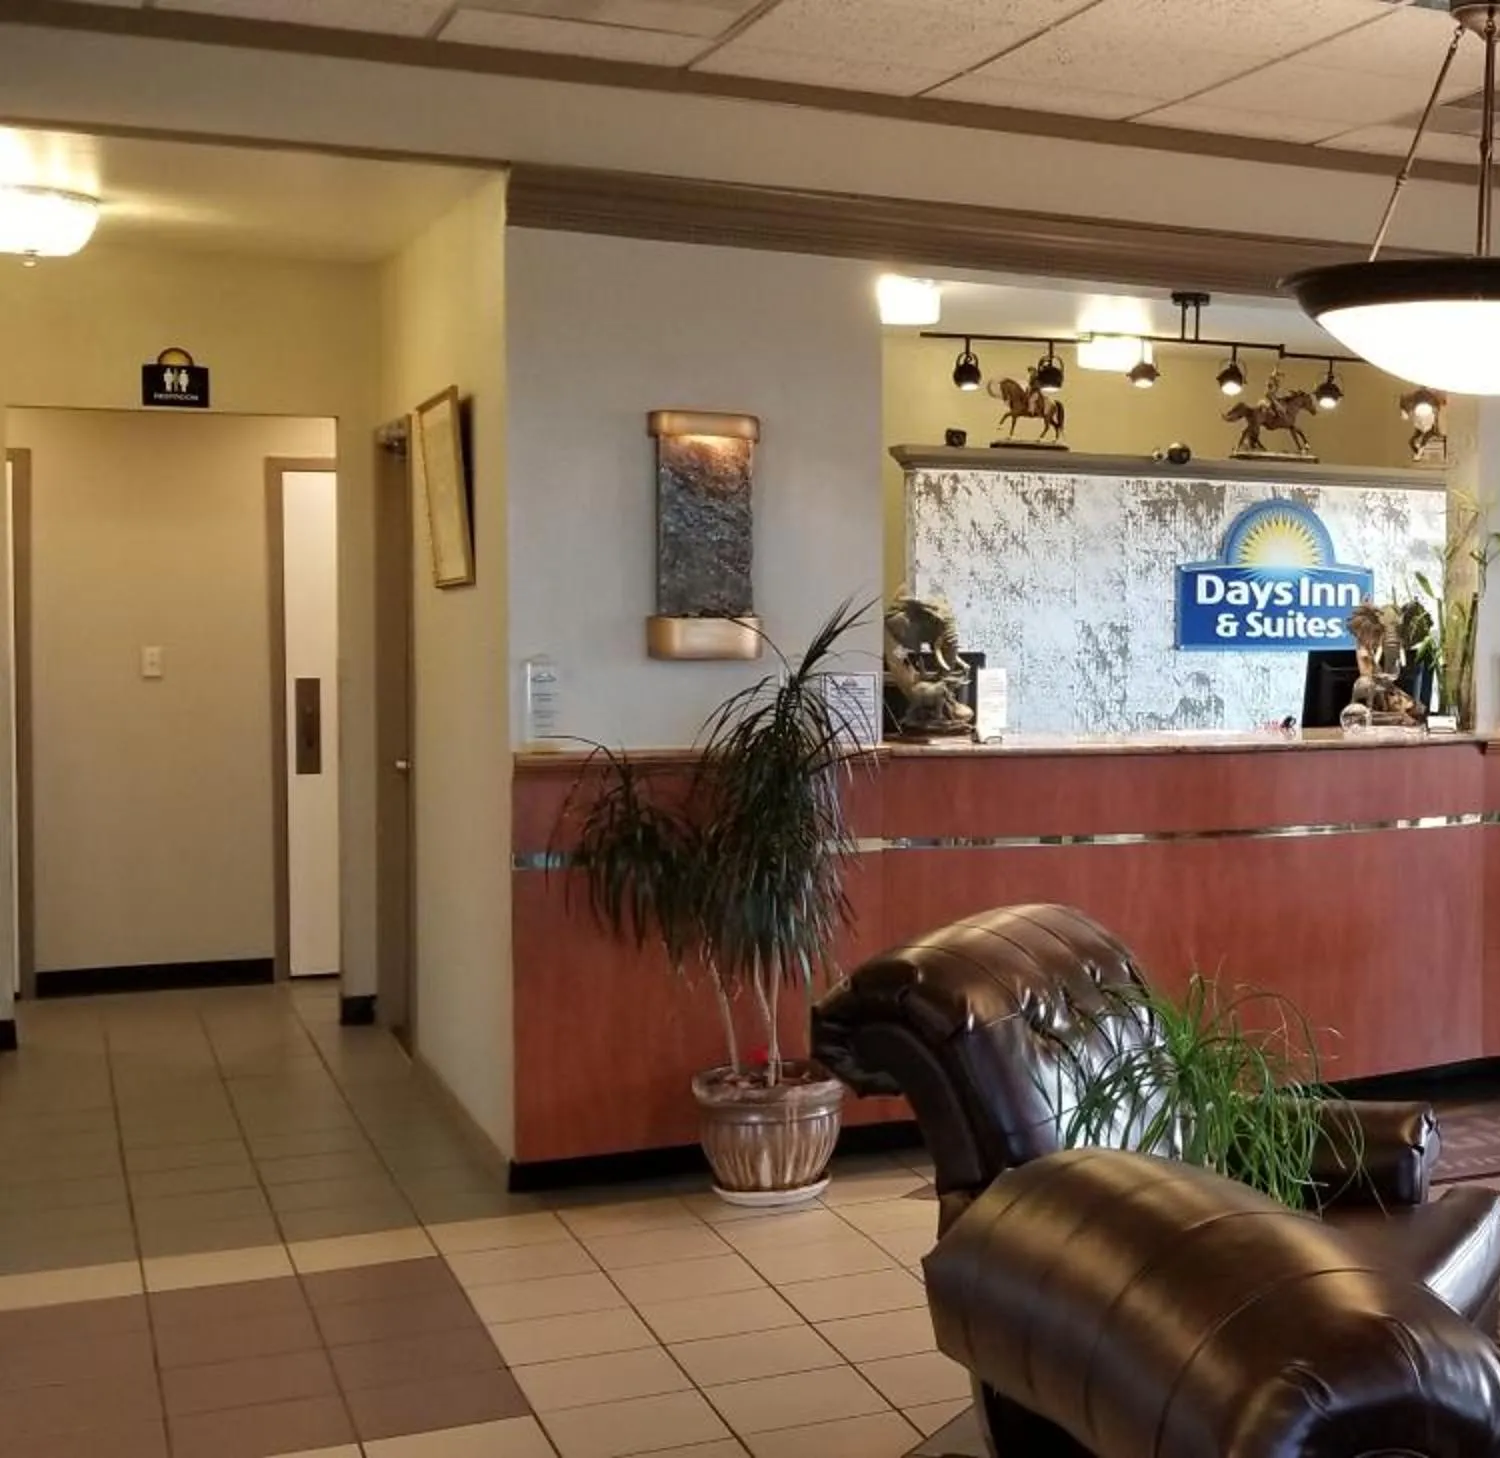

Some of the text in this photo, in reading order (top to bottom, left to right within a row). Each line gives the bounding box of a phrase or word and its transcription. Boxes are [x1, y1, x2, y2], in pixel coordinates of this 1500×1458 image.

[1196, 573, 1361, 611] Days Inn
[1216, 610, 1342, 638] & Suites
